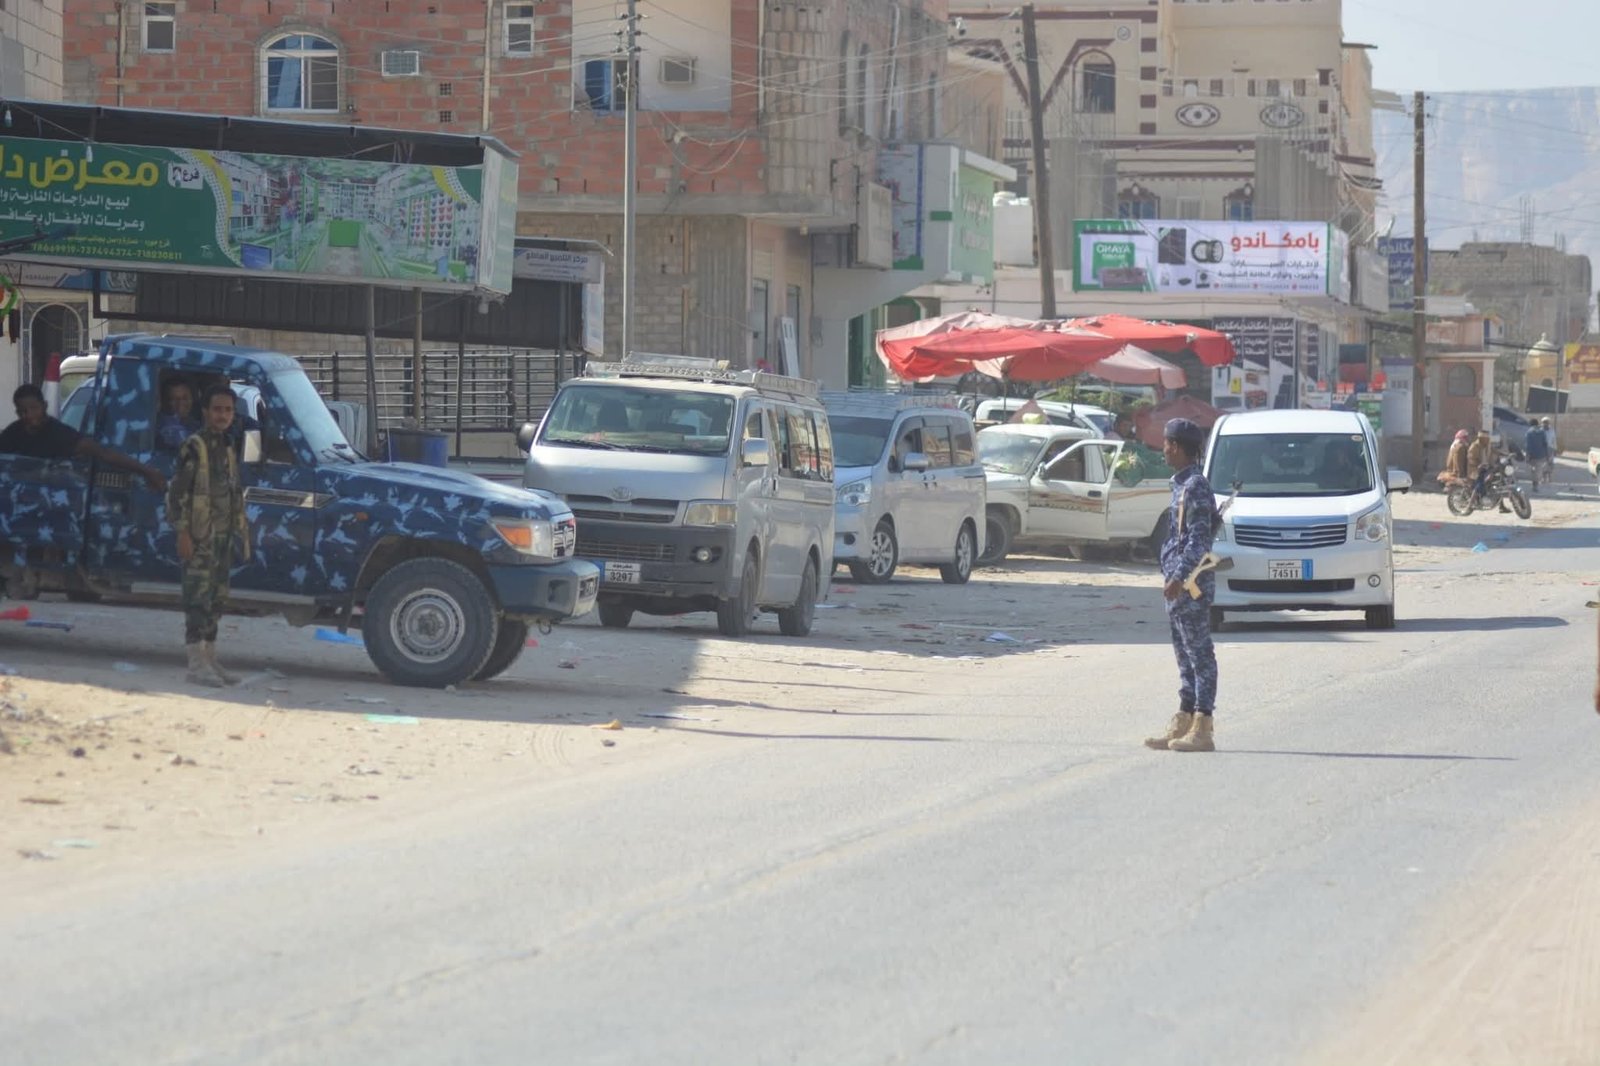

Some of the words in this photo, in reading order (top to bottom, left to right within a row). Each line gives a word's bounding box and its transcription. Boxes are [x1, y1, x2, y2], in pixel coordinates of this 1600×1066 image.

[29, 149, 160, 191] معرض
[183, 168, 200, 182] فرع
[9, 188, 51, 205] النارية
[53, 192, 103, 207] الدراجات
[105, 196, 130, 210] لبيع
[44, 211, 93, 226] الأطفال
[1231, 231, 1319, 253] بامكاندو
[610, 571, 633, 582] 3297
[1272, 569, 1298, 578] 74511
